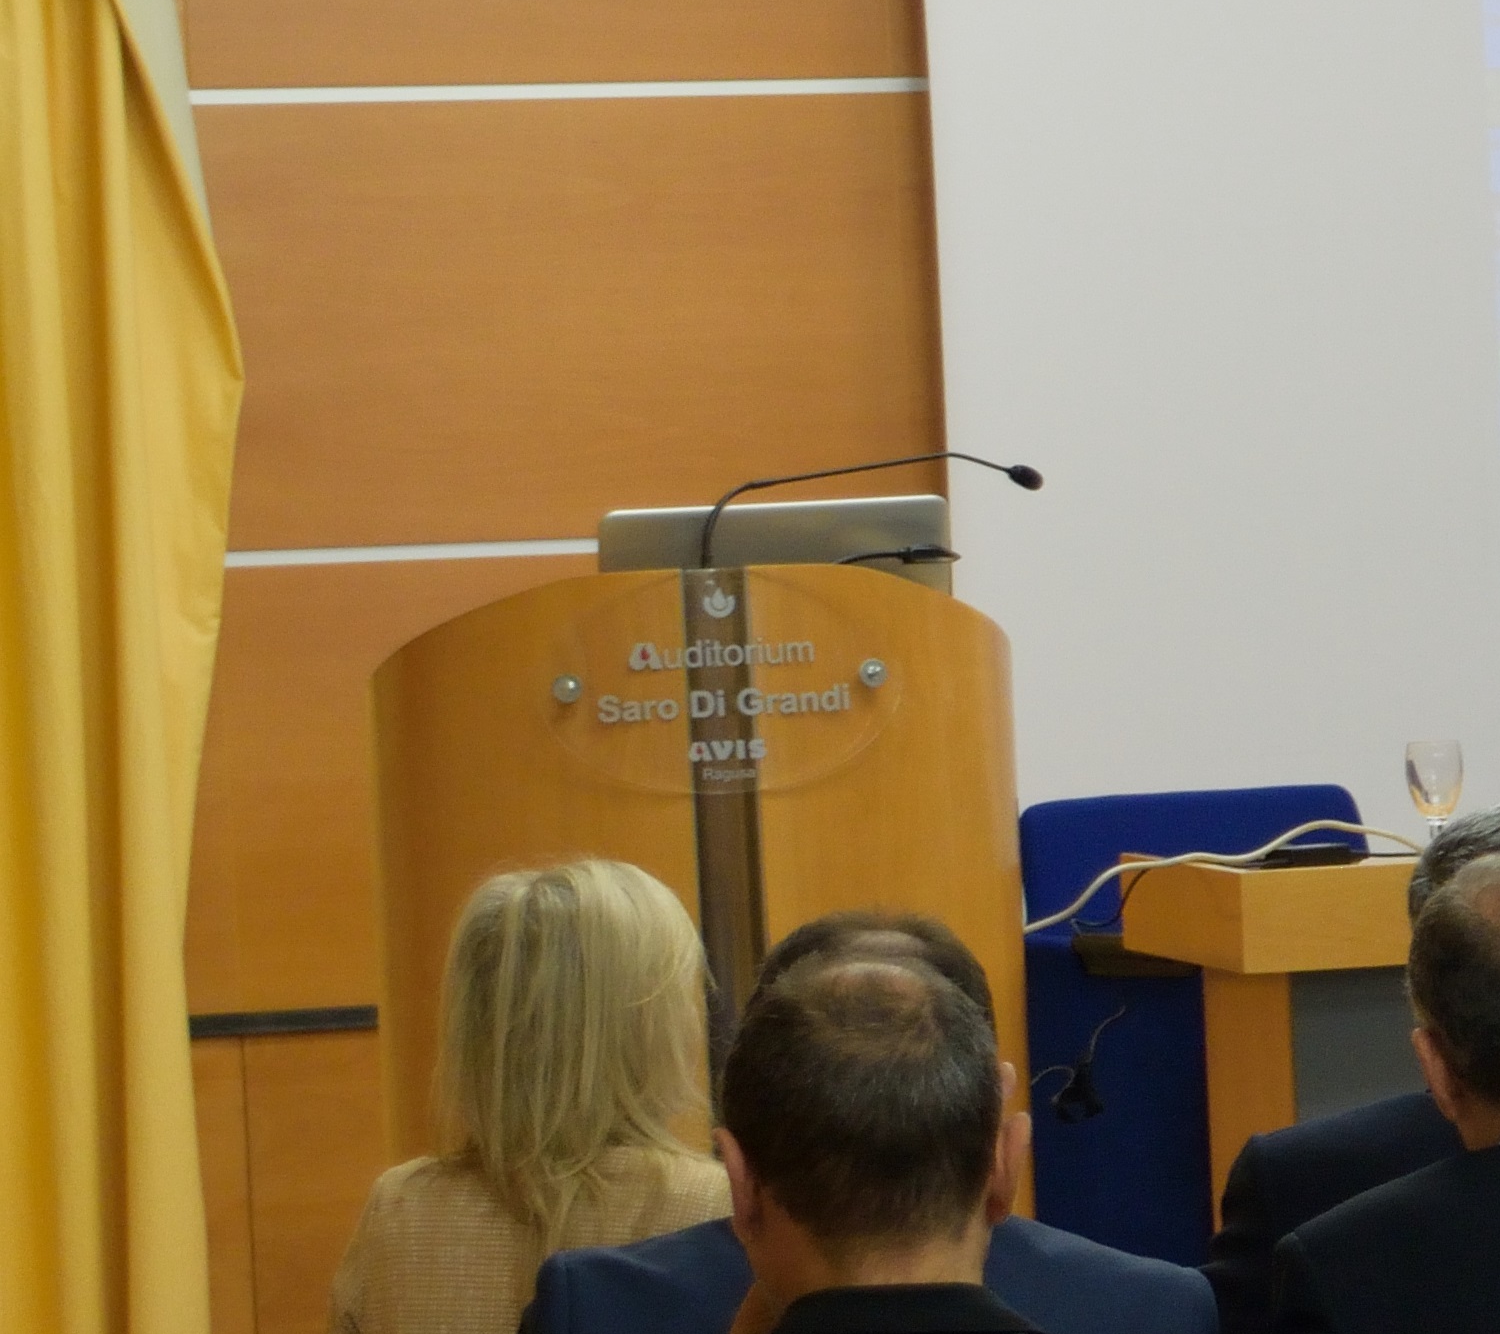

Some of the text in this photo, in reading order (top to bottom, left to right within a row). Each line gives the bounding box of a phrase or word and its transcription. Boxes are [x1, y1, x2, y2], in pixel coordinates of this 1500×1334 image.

[629, 637, 815, 671] Auditorium
[598, 682, 852, 724] Saro Di Grandi
[689, 738, 767, 763] AVIS
